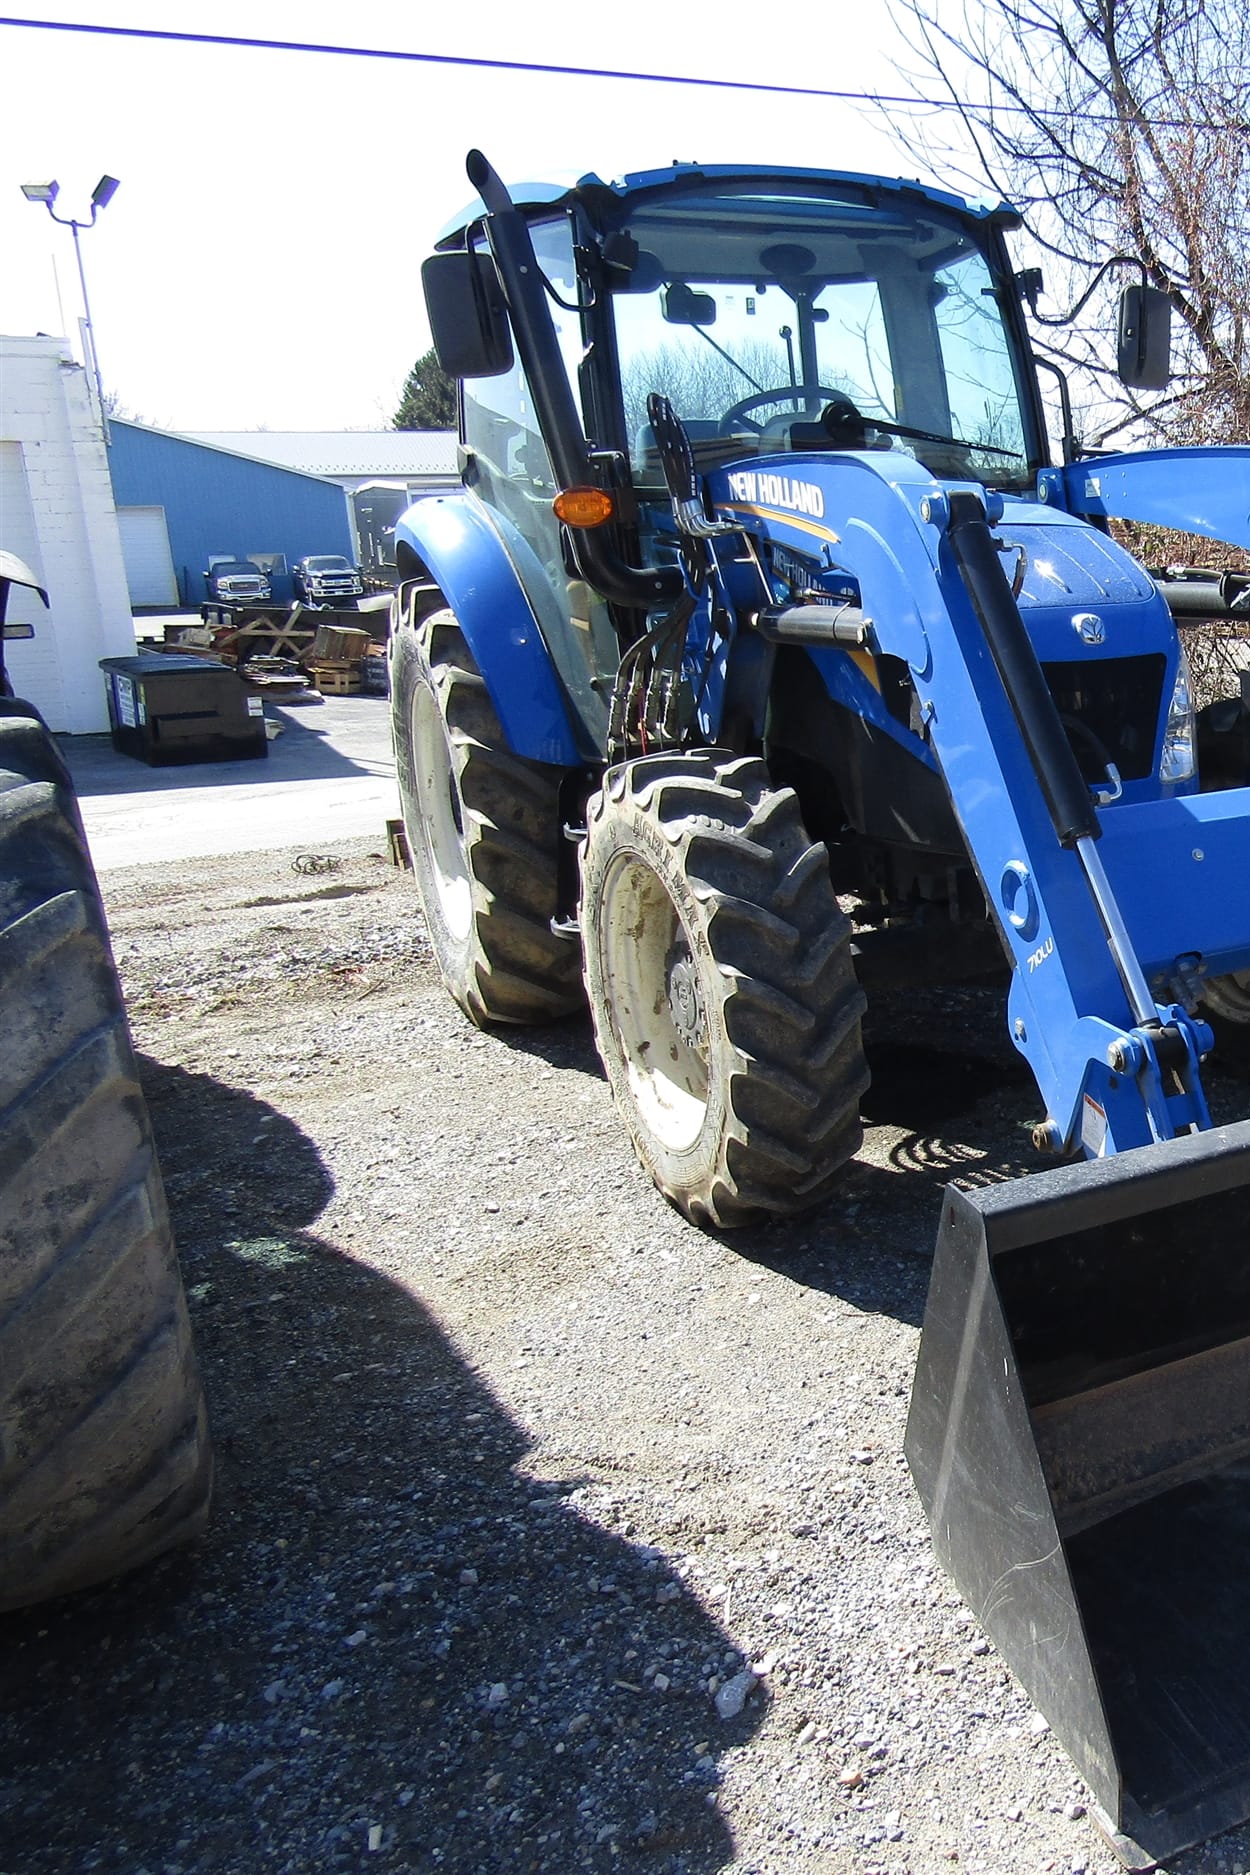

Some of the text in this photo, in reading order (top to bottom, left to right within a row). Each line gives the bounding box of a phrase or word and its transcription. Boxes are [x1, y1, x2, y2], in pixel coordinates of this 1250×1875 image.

[728, 472, 825, 519] NEW HOLLAND
[1027, 937, 1054, 973] 710LU
